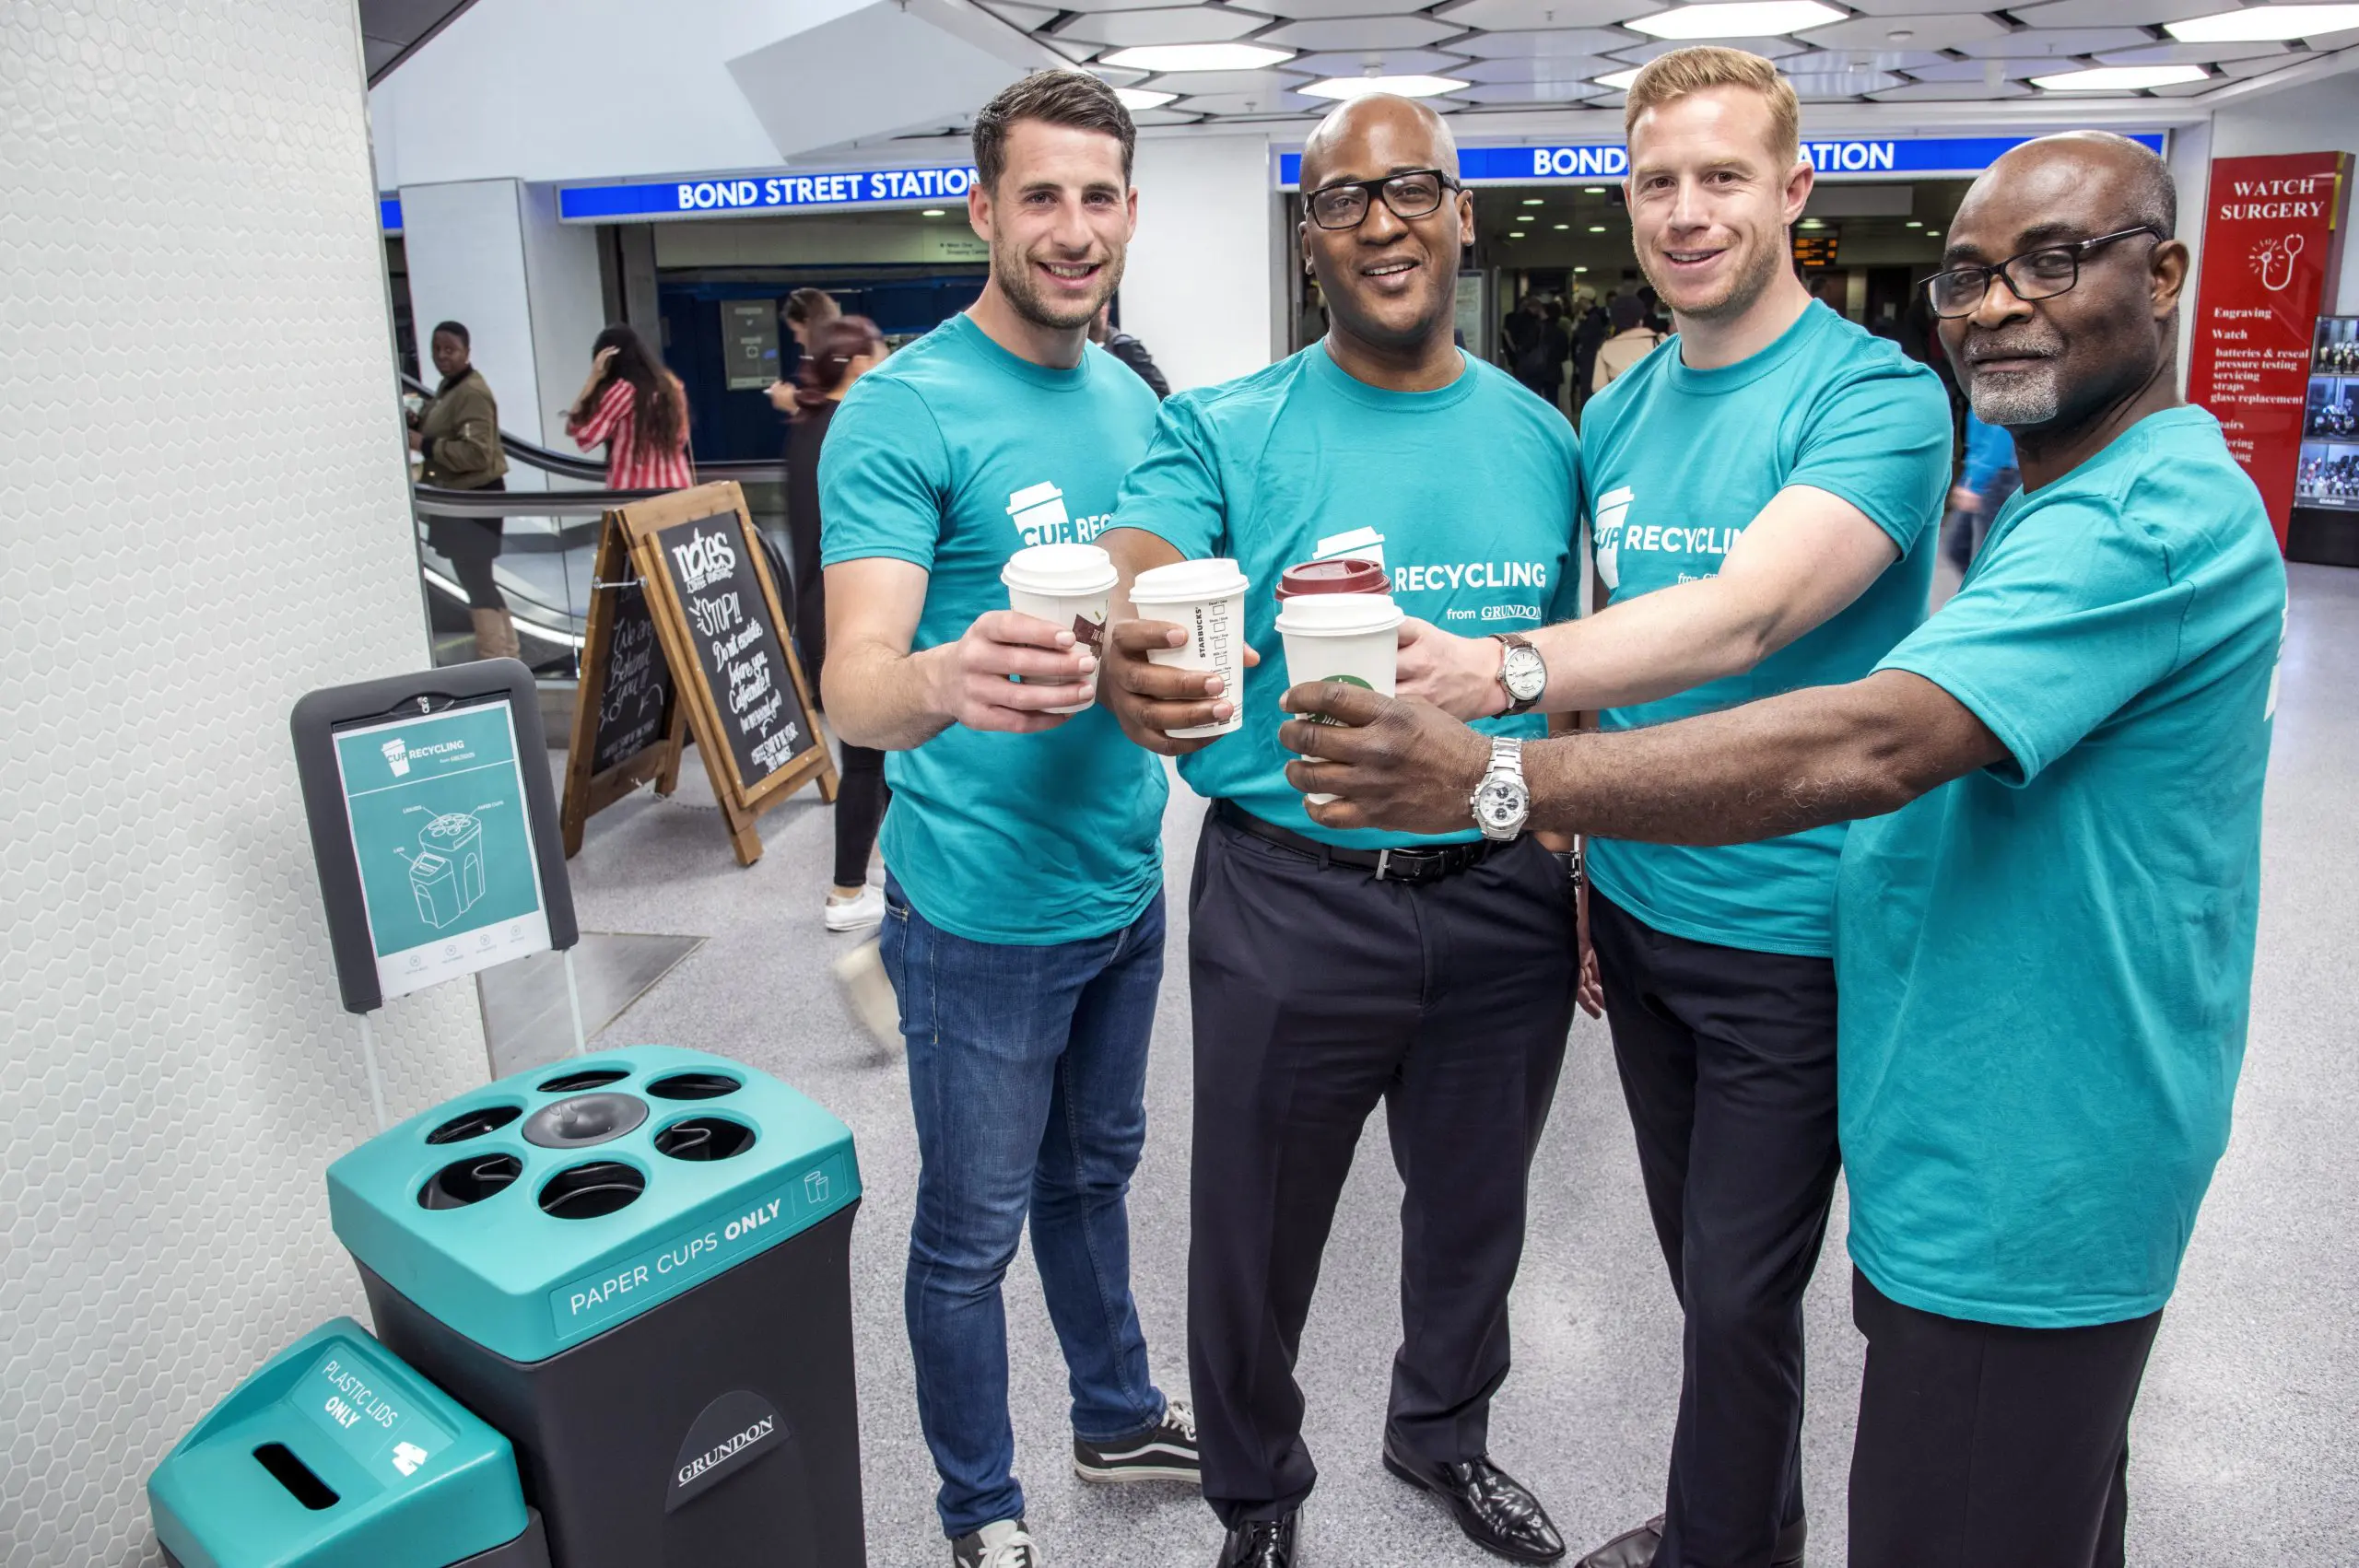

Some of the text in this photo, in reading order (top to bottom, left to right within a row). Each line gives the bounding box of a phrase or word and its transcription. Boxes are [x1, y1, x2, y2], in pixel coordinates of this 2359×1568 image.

[1534, 142, 1895, 175] BOND ATION
[678, 181, 757, 209] BOND
[765, 175, 863, 204] STREET
[2234, 179, 2315, 197] WATCH
[2220, 202, 2325, 220] SURGERY
[2213, 307, 2272, 321] Engraving
[2212, 329, 2248, 340] Watch
[2215, 347, 2309, 358] batteries & reseal
[2213, 370, 2260, 382] servicing
[2214, 360, 2297, 372] pressure testing
[2212, 382, 2245, 393] straps
[2211, 392, 2304, 405] glass replacement
[1020, 522, 1070, 545] CUP
[1625, 525, 1742, 554] RECYCLI
[672, 527, 736, 582] notes
[1394, 561, 1546, 592] RECYCLING
[1447, 608, 1476, 620] from
[1195, 608, 1206, 659] STARBUCKS
[408, 740, 465, 760] RECYCLING
[570, 1198, 781, 1316] PAPER CUPS ONLY
[322, 1360, 398, 1428] PLASTIC LIDS
[324, 1396, 361, 1429] ONLY
[678, 1414, 774, 1487] GRUNDON
